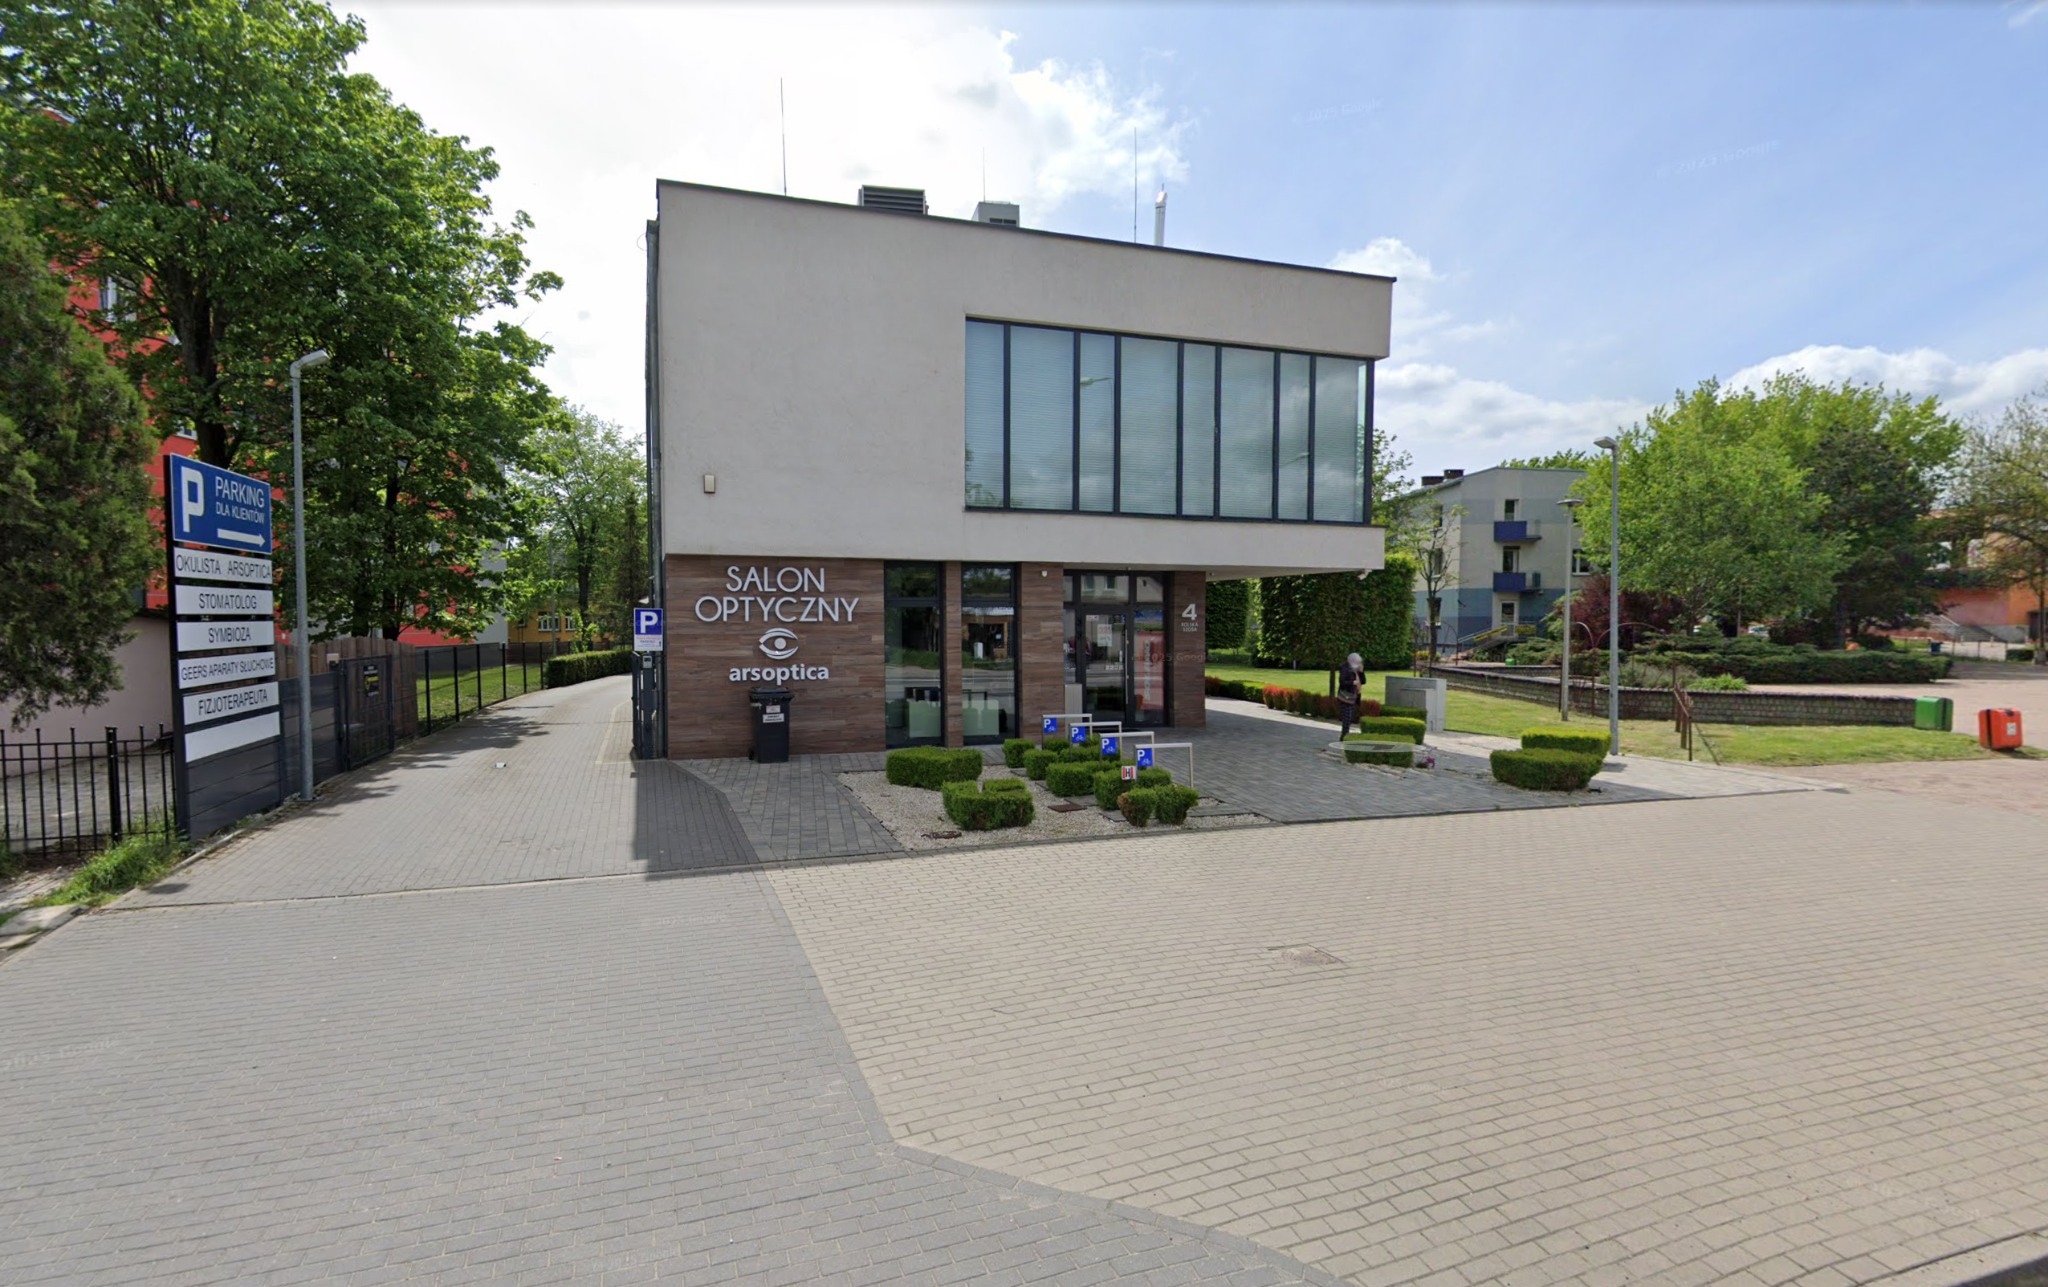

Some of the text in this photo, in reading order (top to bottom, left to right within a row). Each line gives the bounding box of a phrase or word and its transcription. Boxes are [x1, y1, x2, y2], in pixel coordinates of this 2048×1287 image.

[181, 466, 204, 533] P
[215, 476, 265, 508] PARKING
[216, 501, 265, 524] DLA KLIENTÓW
[176, 554, 271, 579] OKULISTA ARSOPTICA
[726, 565, 825, 592] SALON
[198, 593, 257, 609] STOMATOLOG
[695, 596, 859, 622] OPTYCZNY
[1181, 603, 1198, 621] 4
[640, 611, 659, 634] P
[208, 627, 251, 644] SYMBIOZA
[181, 664, 207, 681] GEERS
[208, 661, 239, 677] APARATY
[729, 663, 829, 685] arsoptica
[198, 689, 268, 716] FIZJOTERAPEUTA
[1043, 719, 1051, 729] P
[1071, 727, 1079, 738] P
[1101, 738, 1110, 749] P
[1137, 749, 1145, 761] P
